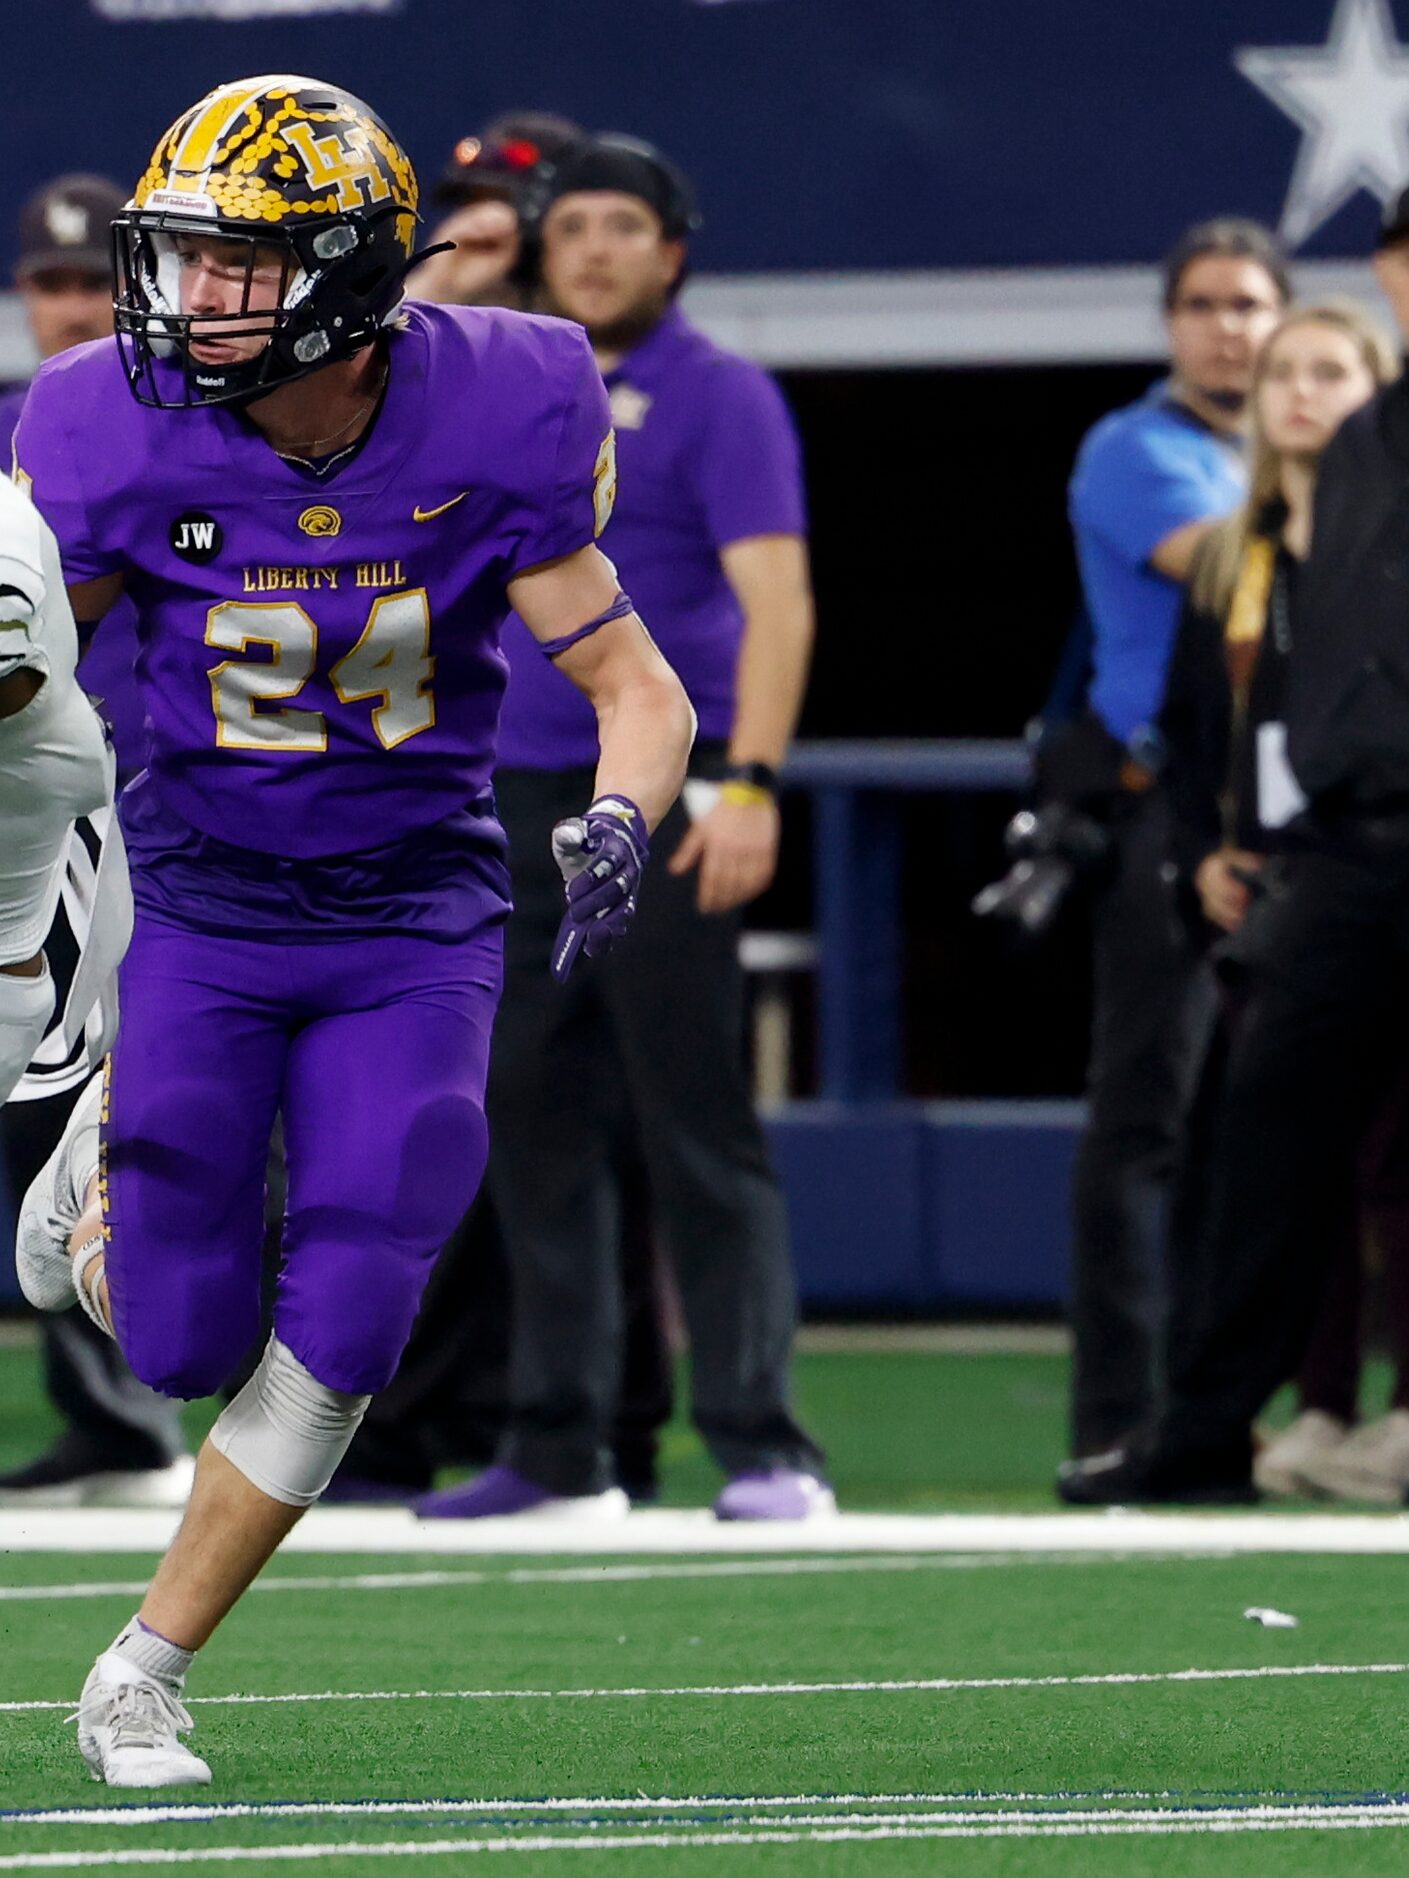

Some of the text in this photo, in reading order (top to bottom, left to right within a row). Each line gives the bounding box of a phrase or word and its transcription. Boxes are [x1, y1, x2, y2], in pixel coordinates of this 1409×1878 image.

[279, 121, 391, 213] LH
[174, 522, 216, 550] JW
[243, 560, 407, 592] LIBERTY HILL
[204, 587, 436, 752] 24
